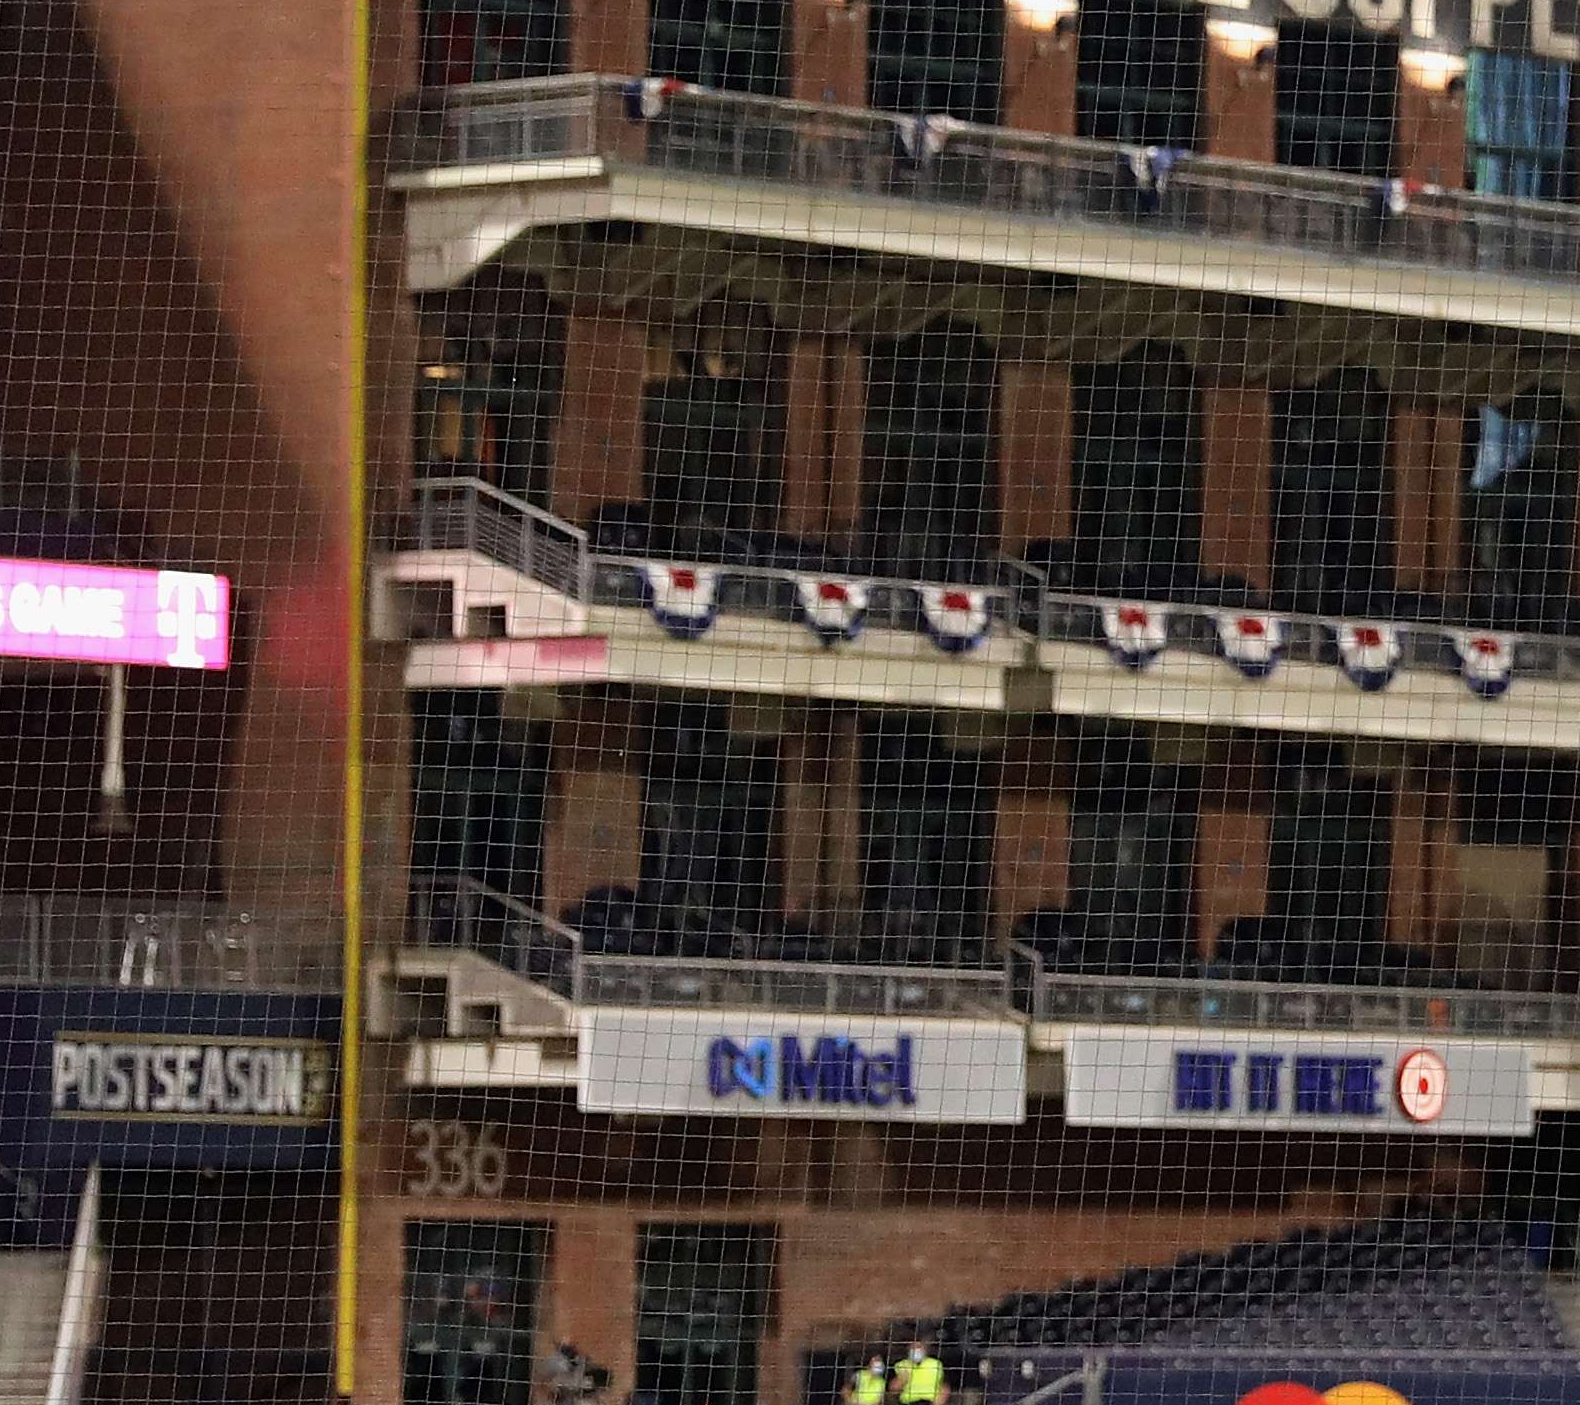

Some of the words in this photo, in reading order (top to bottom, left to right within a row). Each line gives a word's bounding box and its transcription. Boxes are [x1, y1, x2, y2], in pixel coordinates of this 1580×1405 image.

[8, 581, 125, 639] GAME
[52, 1043, 303, 1116] POSTSEASON
[780, 1033, 916, 1107] Mitel
[407, 1118, 508, 1196] 336
